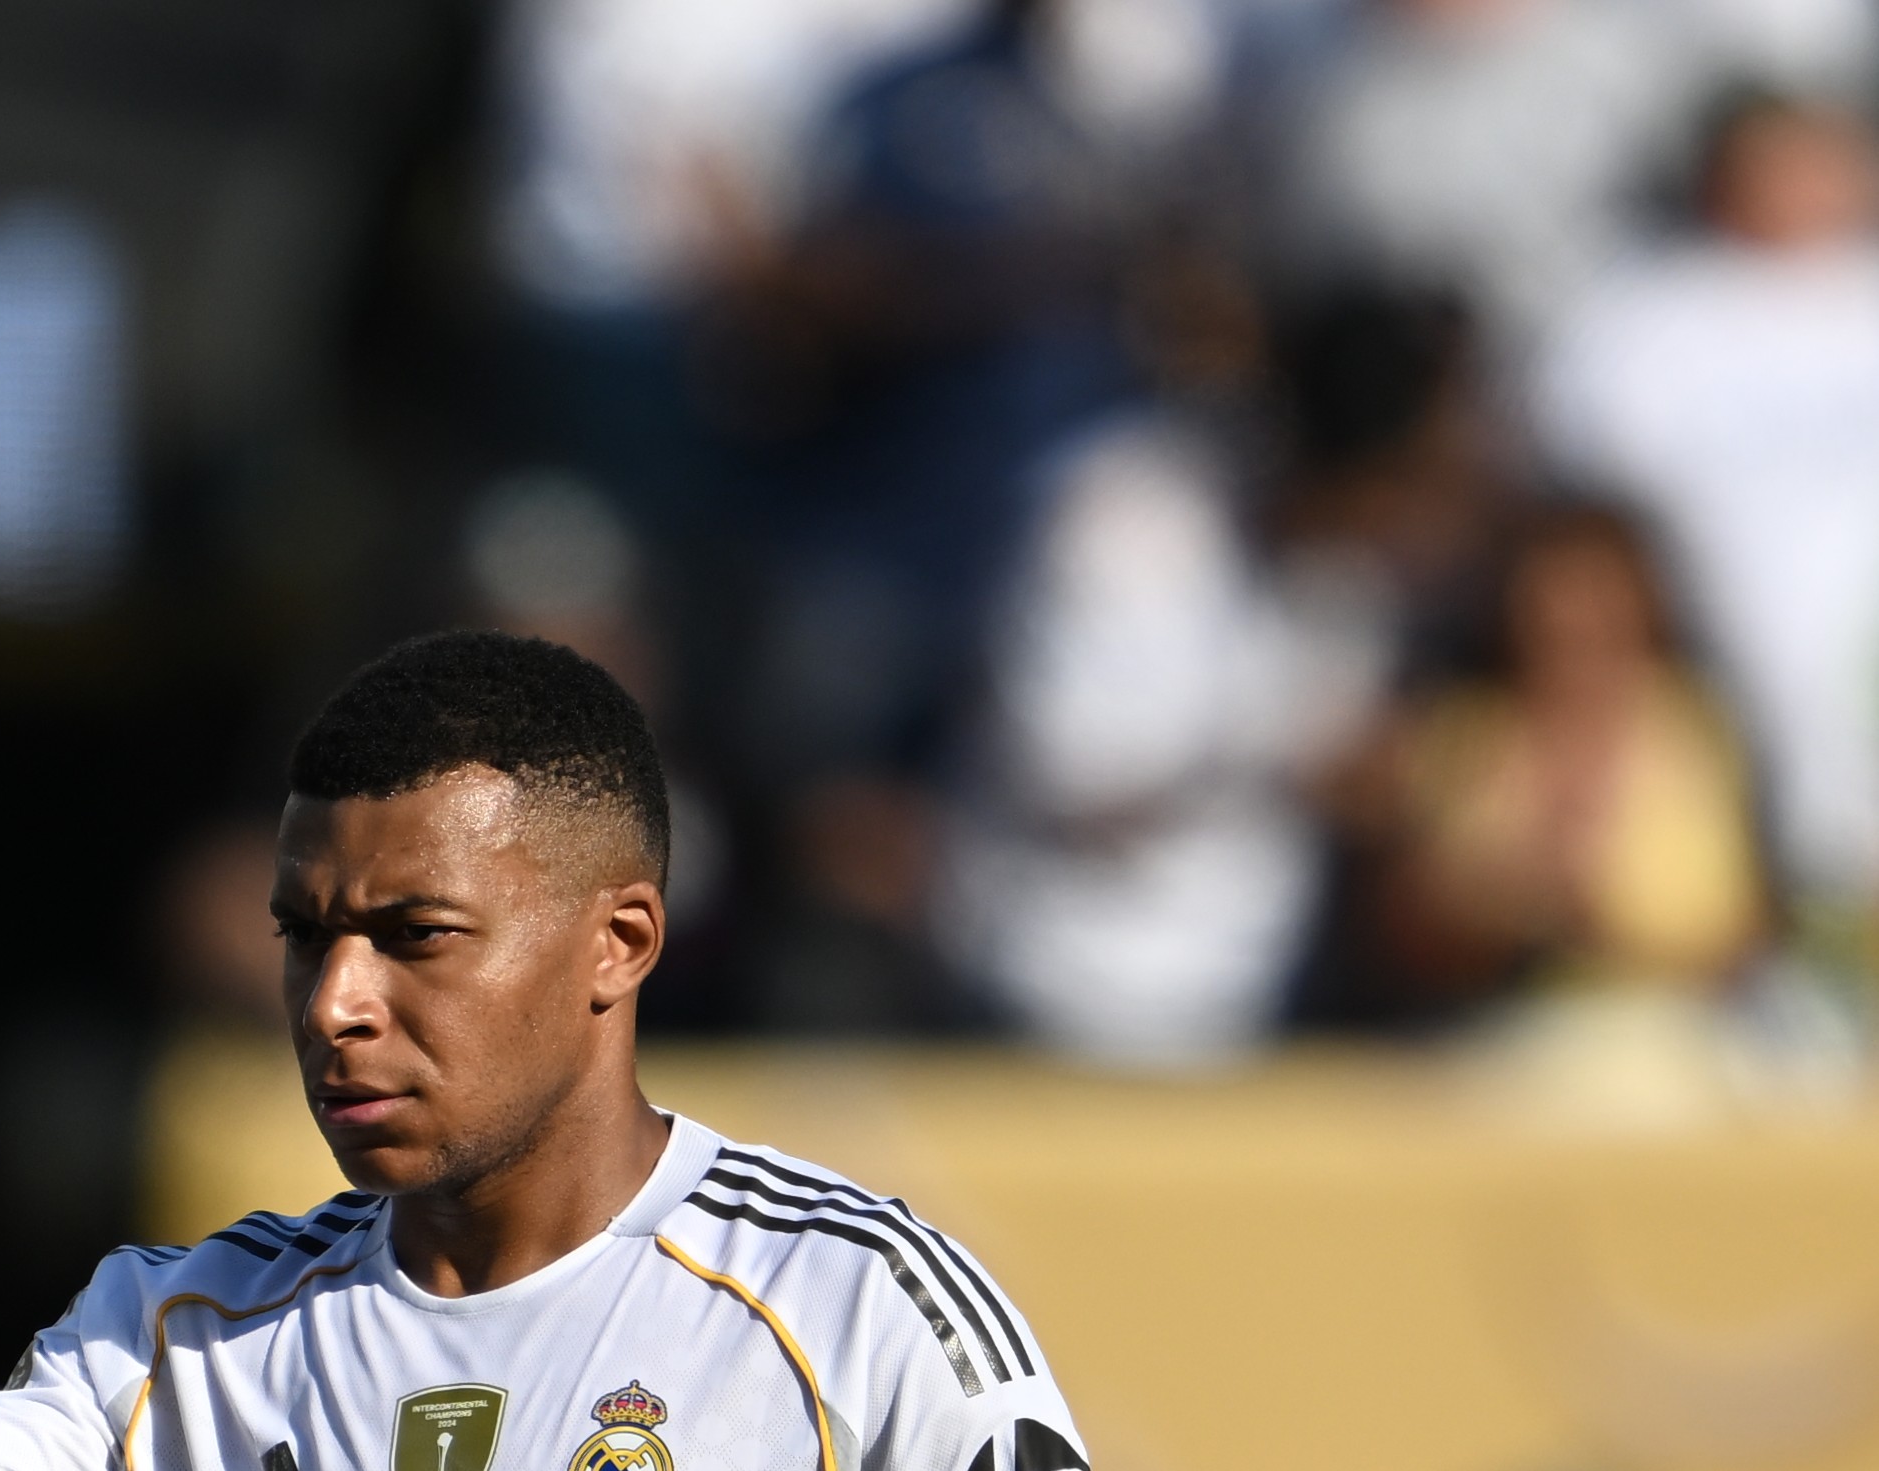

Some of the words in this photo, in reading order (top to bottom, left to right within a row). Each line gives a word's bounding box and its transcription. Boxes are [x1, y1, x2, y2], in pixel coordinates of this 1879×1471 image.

[412, 1400, 489, 1413] INTERCONTINENTAL
[425, 1410, 473, 1421] CHAMPIONS
[437, 1419, 457, 1429] 2024
